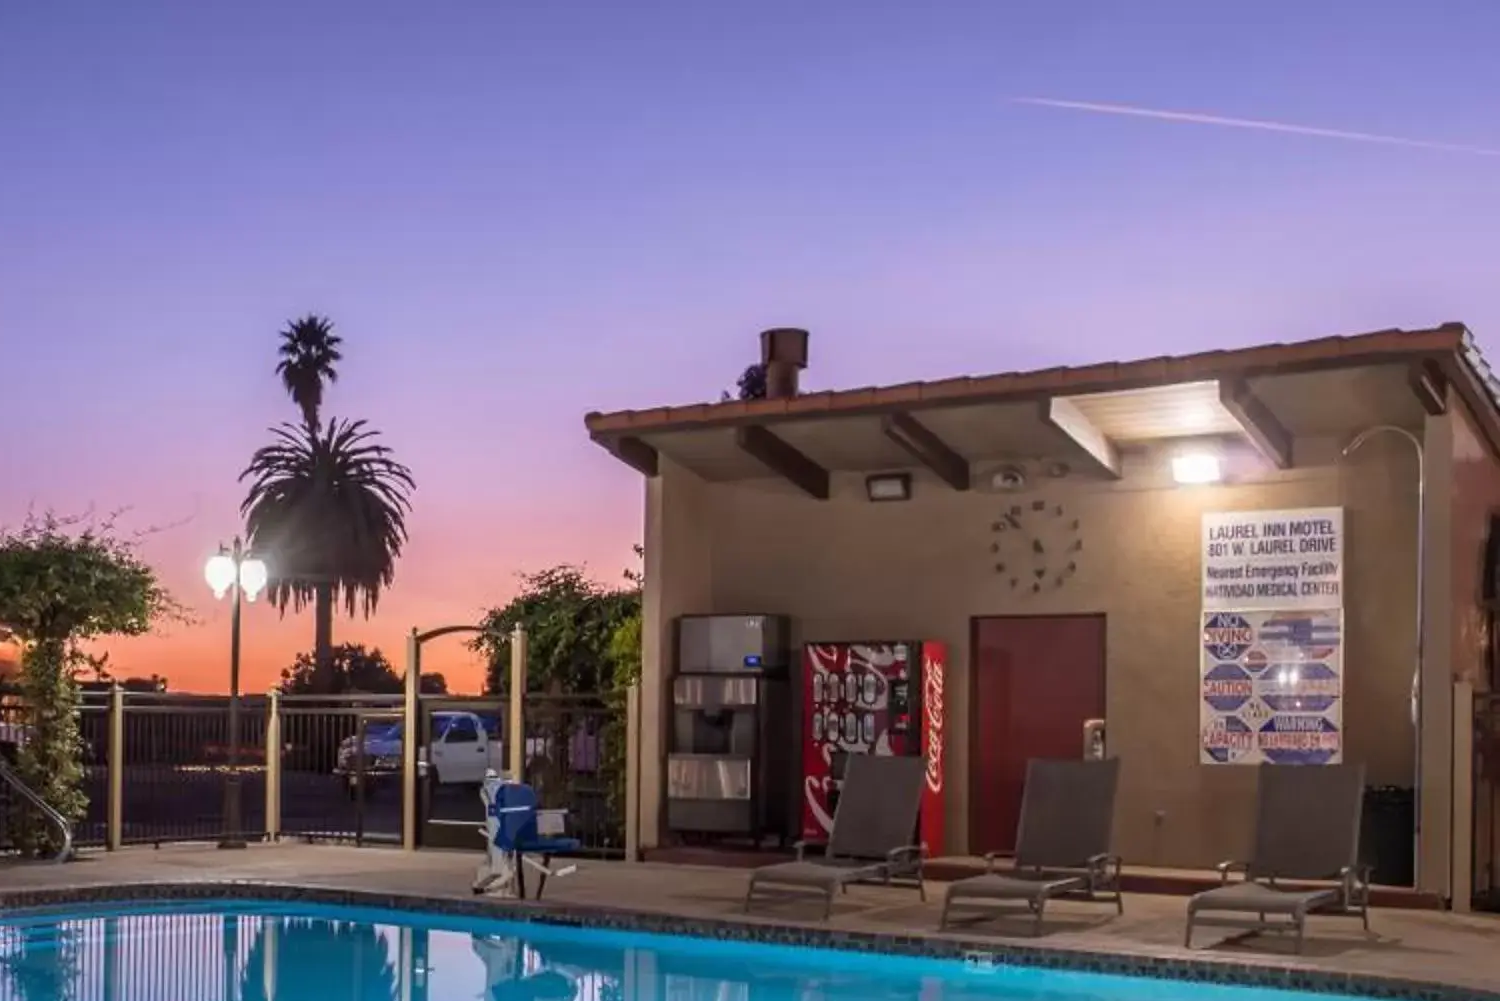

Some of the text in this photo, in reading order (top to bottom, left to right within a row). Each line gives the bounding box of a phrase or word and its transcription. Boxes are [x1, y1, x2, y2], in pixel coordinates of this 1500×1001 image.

[1209, 520, 1335, 540] LAUREL INN MOTEL
[1208, 543, 1228, 557] 801
[1250, 539, 1296, 555] LAUREL
[1299, 537, 1337, 553] DRIVE
[1207, 561, 1338, 580] Nearest Emergency Facility
[1256, 582, 1298, 597] MEDICAL
[1301, 581, 1339, 596] CENTER
[1217, 614, 1239, 628] NO
[1204, 680, 1252, 696] CAUTION
[925, 656, 944, 794] Coca-Cola
[1275, 716, 1323, 732] WARNING
[1204, 732, 1253, 749] CAPACITY
